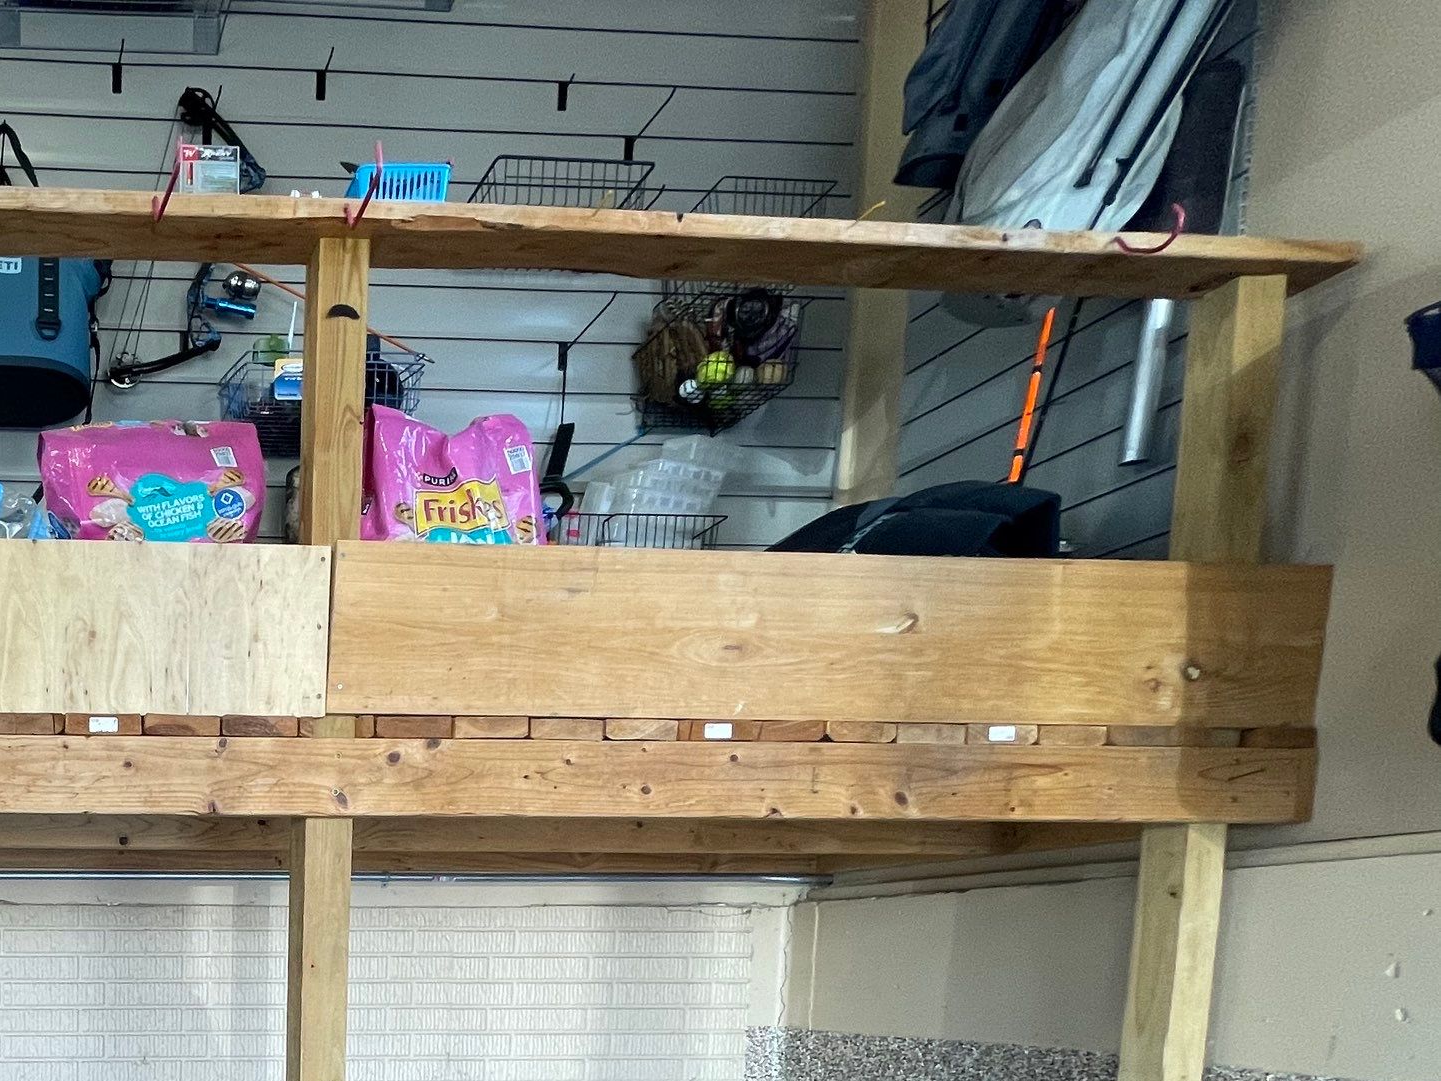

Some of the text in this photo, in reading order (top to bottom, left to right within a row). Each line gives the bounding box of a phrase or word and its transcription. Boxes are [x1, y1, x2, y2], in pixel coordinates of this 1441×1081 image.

[136, 503, 161, 513] WITH
[161, 494, 205, 510] FLAVORS
[142, 512, 153, 520] OF
[155, 503, 194, 518] CHICKEN
[148, 510, 202, 528] OCEAN FISH
